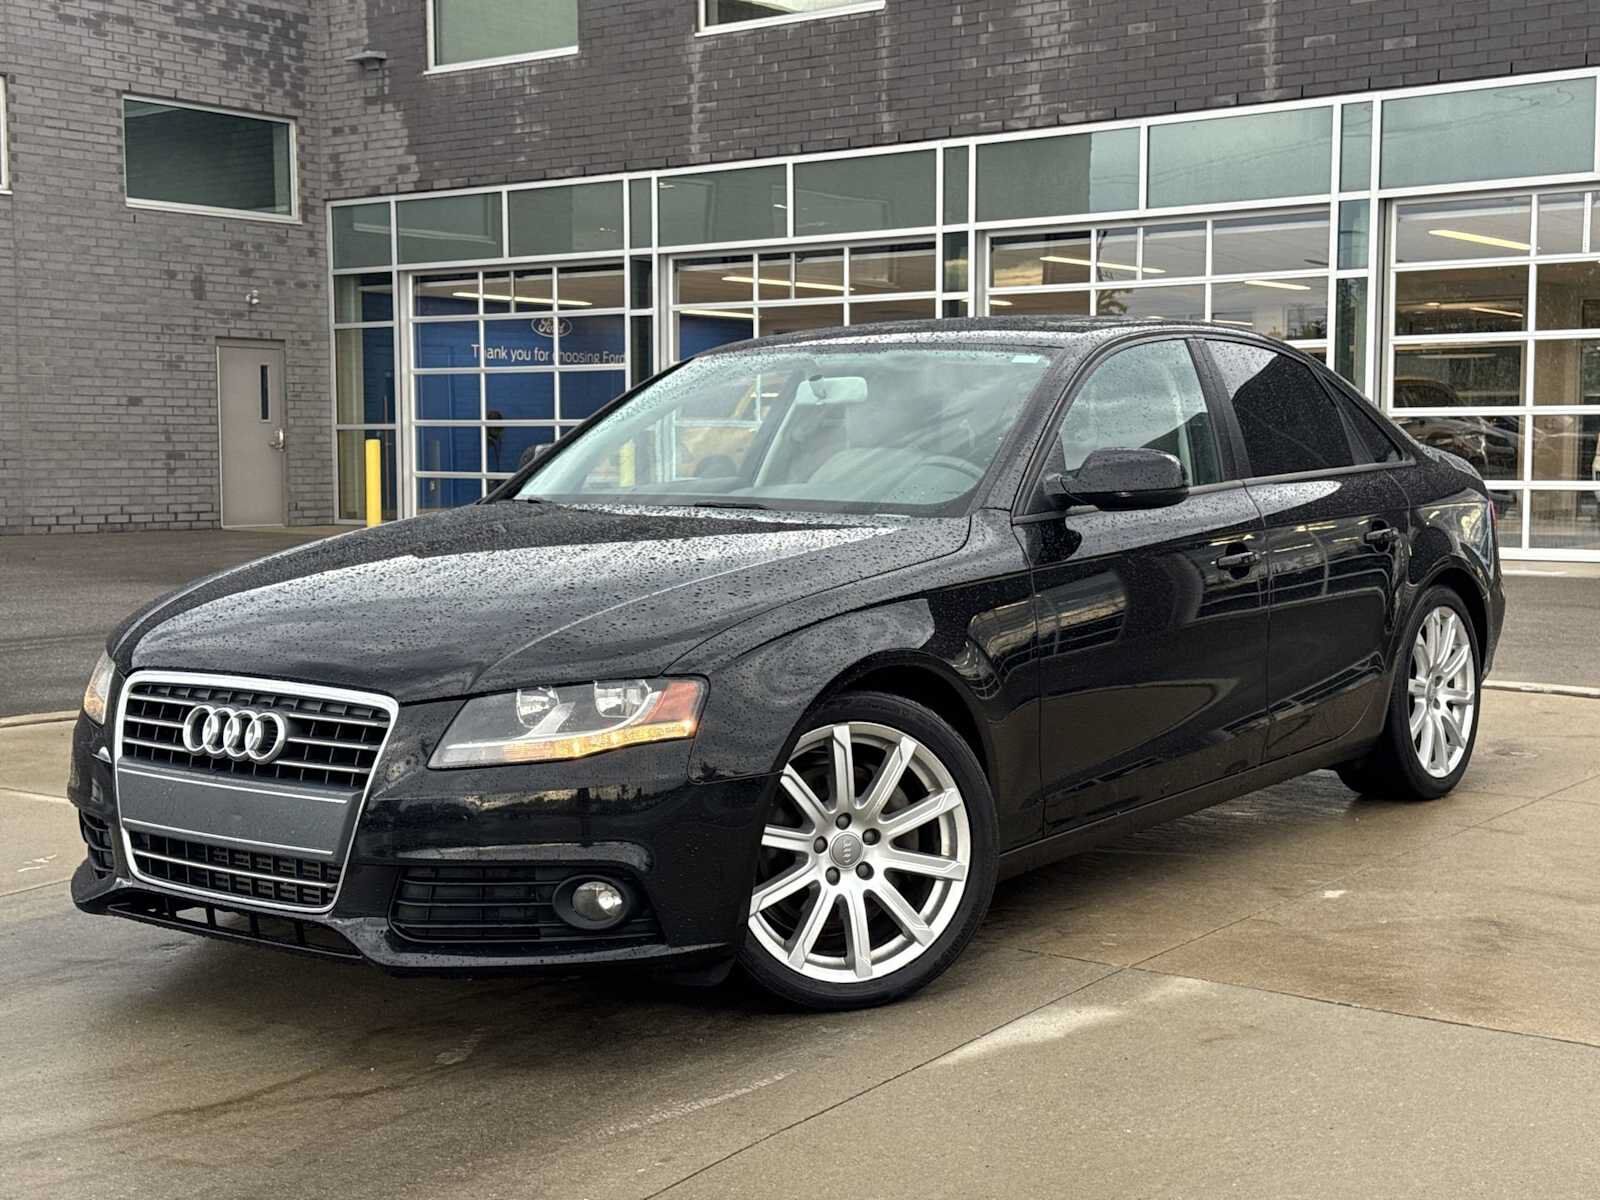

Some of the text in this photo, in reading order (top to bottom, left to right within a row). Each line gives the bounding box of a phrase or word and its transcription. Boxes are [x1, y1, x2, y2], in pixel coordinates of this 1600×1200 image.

[537, 318, 567, 334] Fod
[510, 347, 531, 362] you
[534, 346, 549, 361] for
